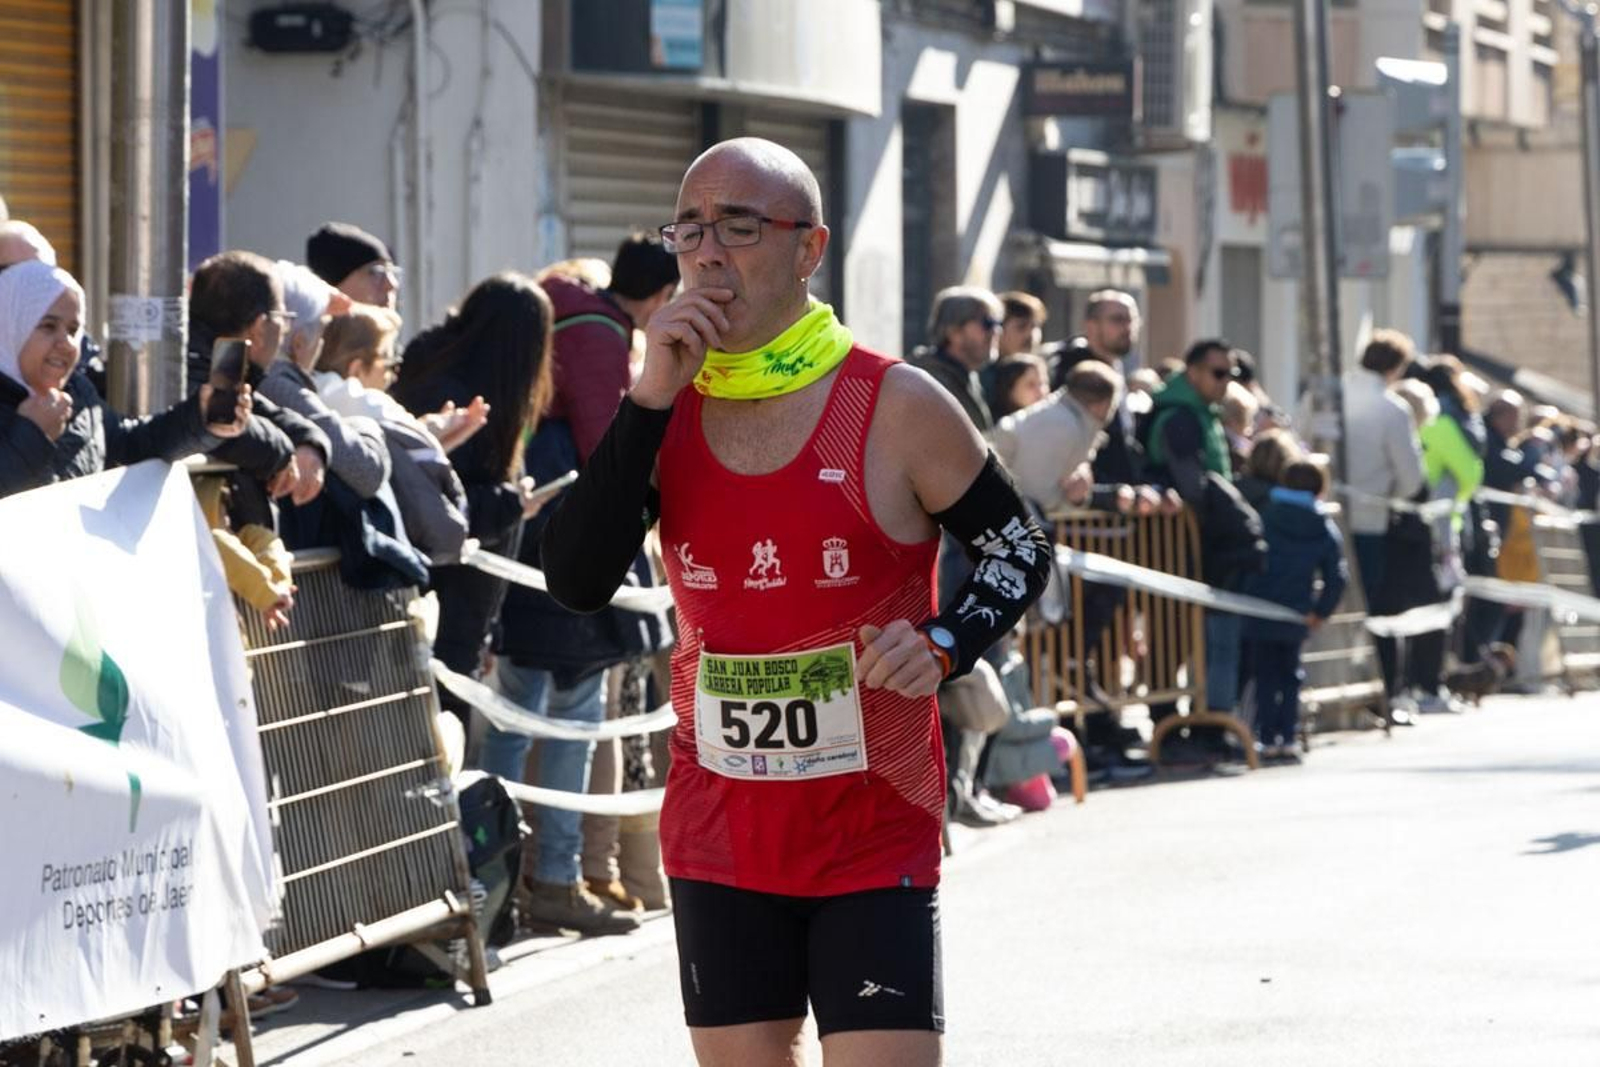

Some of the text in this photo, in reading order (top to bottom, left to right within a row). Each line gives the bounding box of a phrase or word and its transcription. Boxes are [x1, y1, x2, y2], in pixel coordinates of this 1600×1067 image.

[704, 675, 791, 696] CARRERA POPULAR
[707, 659, 798, 677] SAN JUAN BOSCO
[720, 698, 818, 749] 520
[41, 838, 193, 894] Patronato Municpal
[63, 893, 132, 933] Deportes
[138, 885, 157, 915] de
